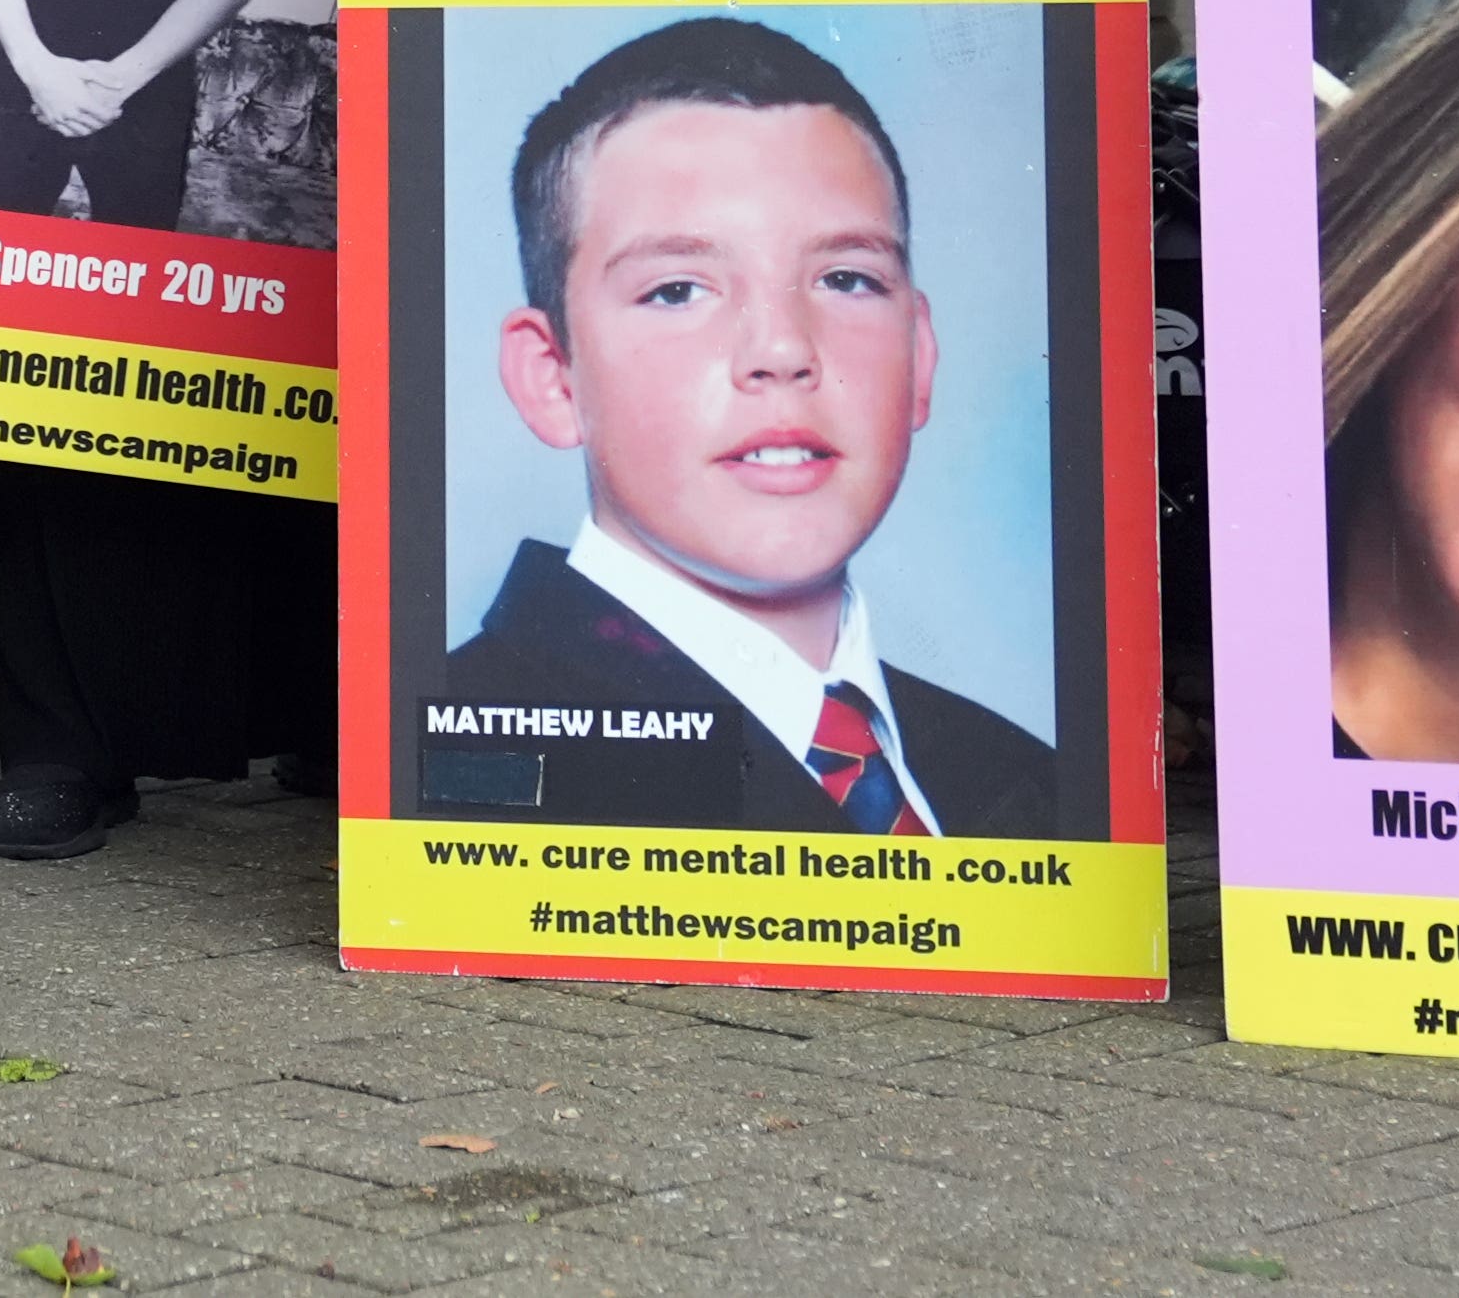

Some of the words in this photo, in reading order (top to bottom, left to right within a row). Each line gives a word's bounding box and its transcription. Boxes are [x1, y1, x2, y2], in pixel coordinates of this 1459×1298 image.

[160, 259, 214, 306] 20
[221, 273, 285, 315] yrs
[427, 705, 594, 737] MATTHEW
[602, 709, 714, 741] LEAHY
[423, 841, 529, 868] www.
[541, 845, 631, 871] cure
[644, 844, 785, 876] mental
[799, 845, 931, 881] health
[945, 853, 1072, 886] .co.uk
